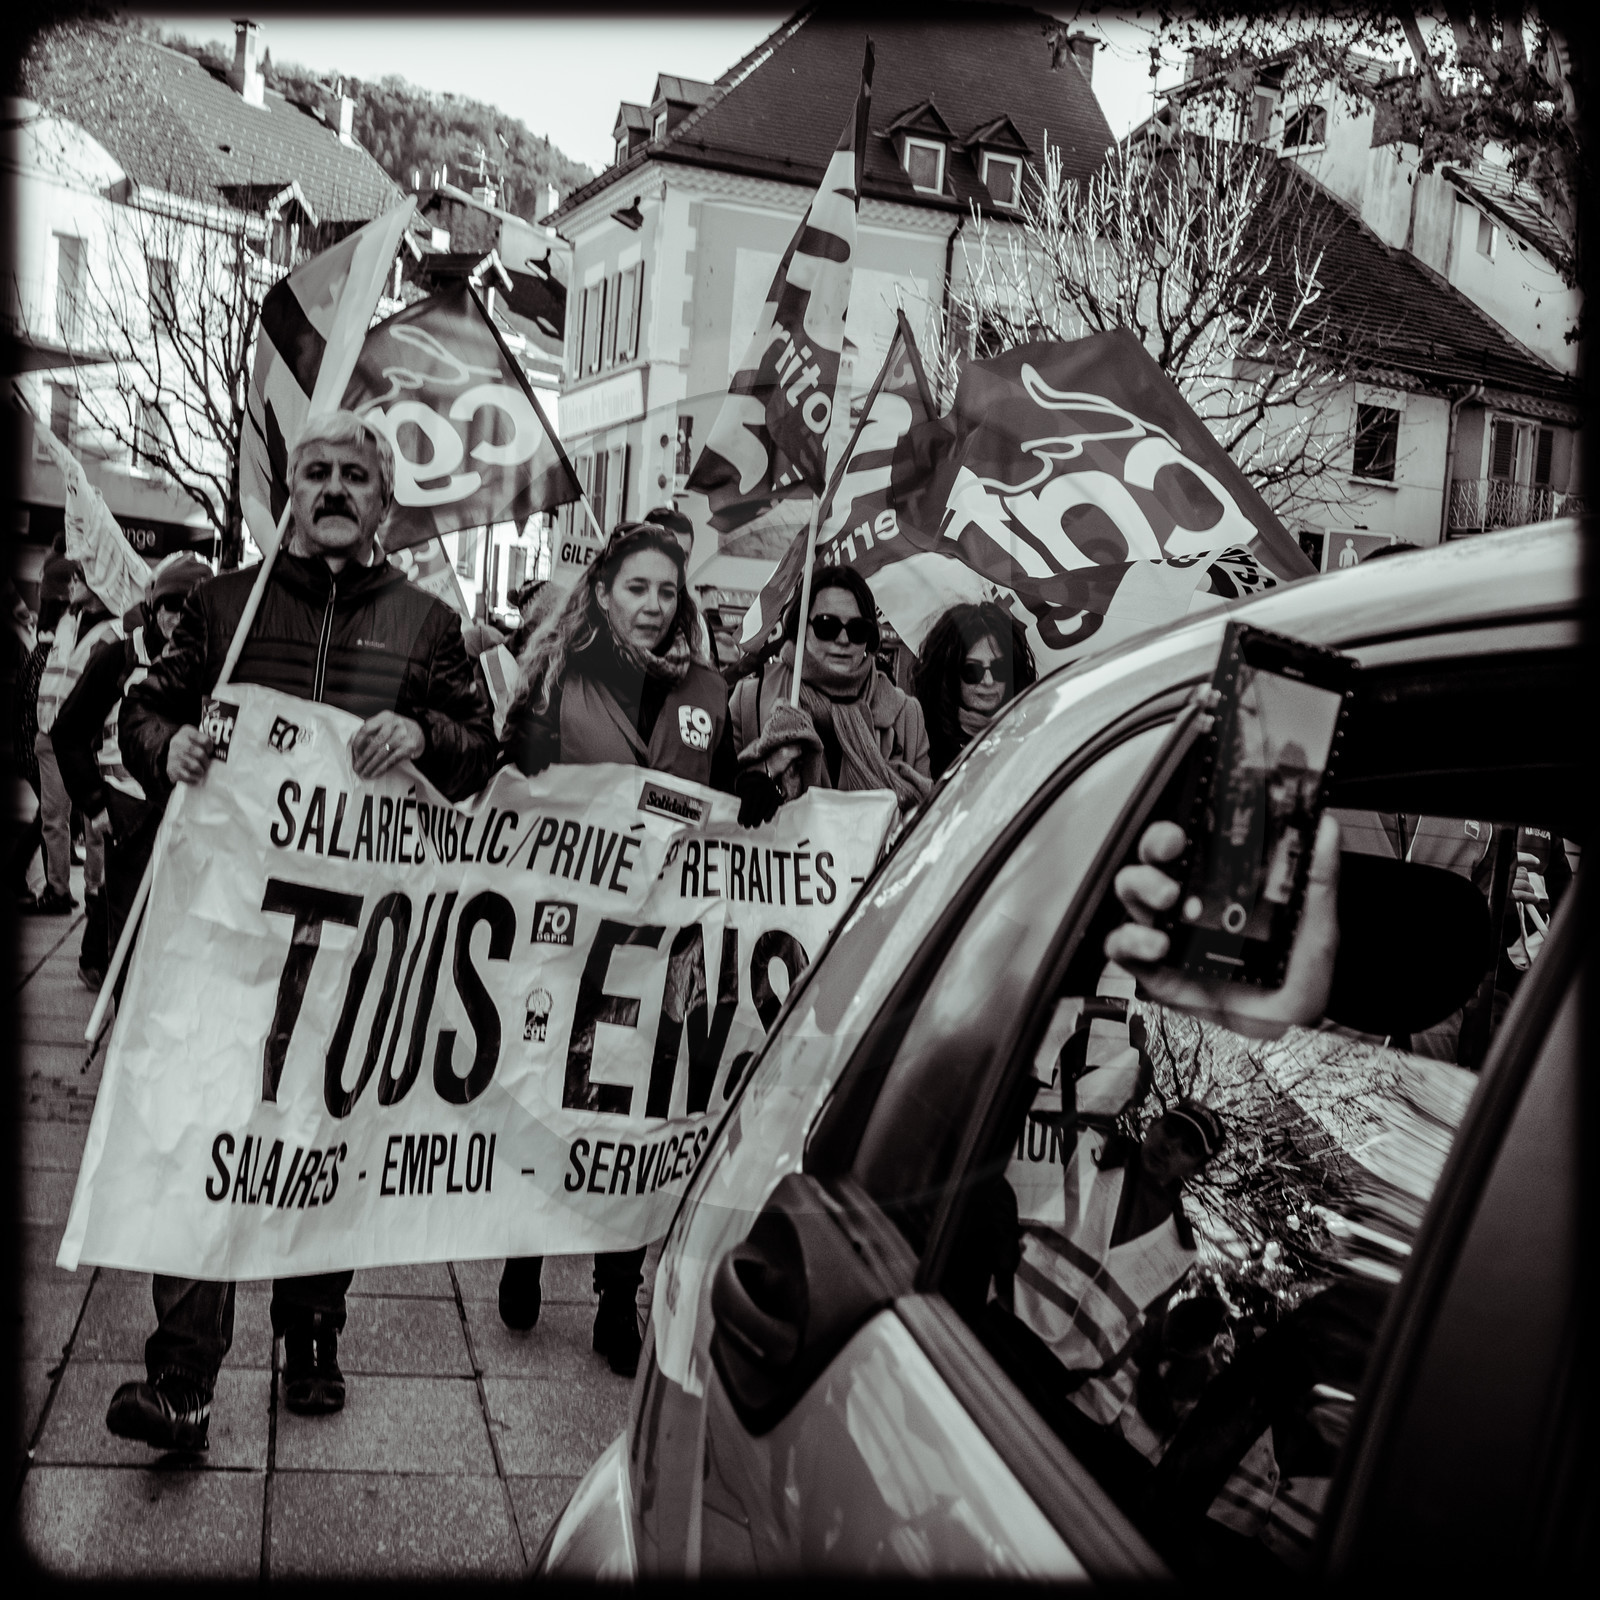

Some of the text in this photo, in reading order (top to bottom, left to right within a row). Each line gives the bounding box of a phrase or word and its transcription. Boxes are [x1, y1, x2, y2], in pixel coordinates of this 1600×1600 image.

[561, 542, 595, 566] GILE
[679, 705, 712, 734] FO
[538, 905, 571, 934] FO
[260, 878, 812, 1121] TOUS ENS
[205, 1131, 348, 1210] SALAIRES
[380, 1131, 497, 1197] EMPLOI
[564, 1126, 710, 1196] SERVICES
